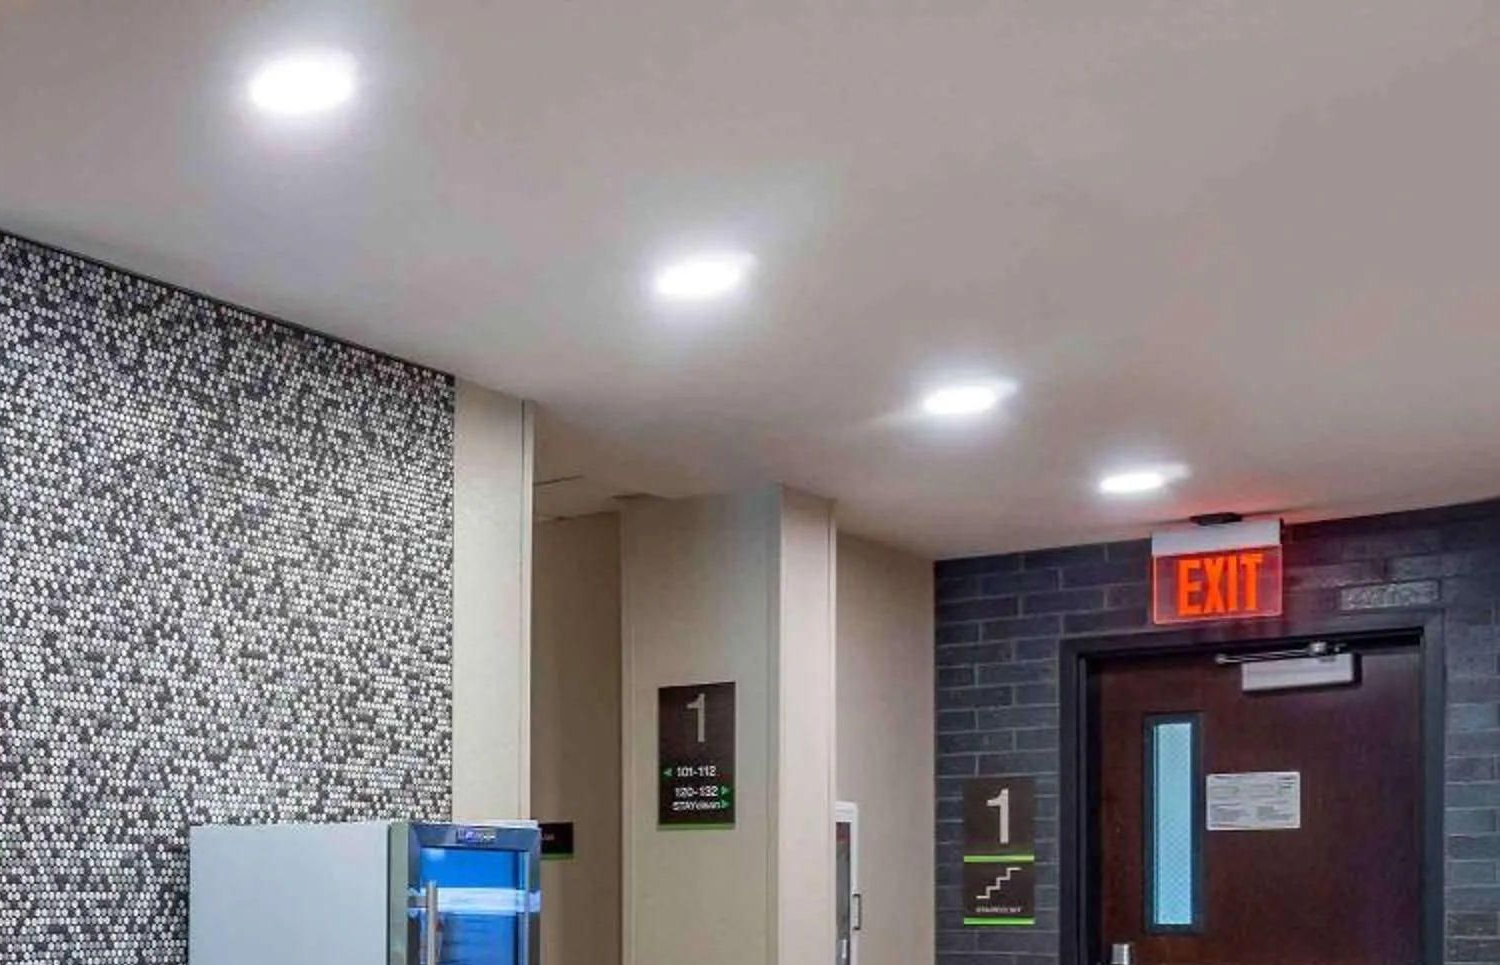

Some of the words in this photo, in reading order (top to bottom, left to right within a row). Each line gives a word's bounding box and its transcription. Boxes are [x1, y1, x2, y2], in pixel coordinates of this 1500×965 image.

[1177, 553, 1263, 616] EXIT
[686, 692, 706, 743] 1
[677, 765, 717, 777] 101-112
[986, 788, 1009, 844] 1
